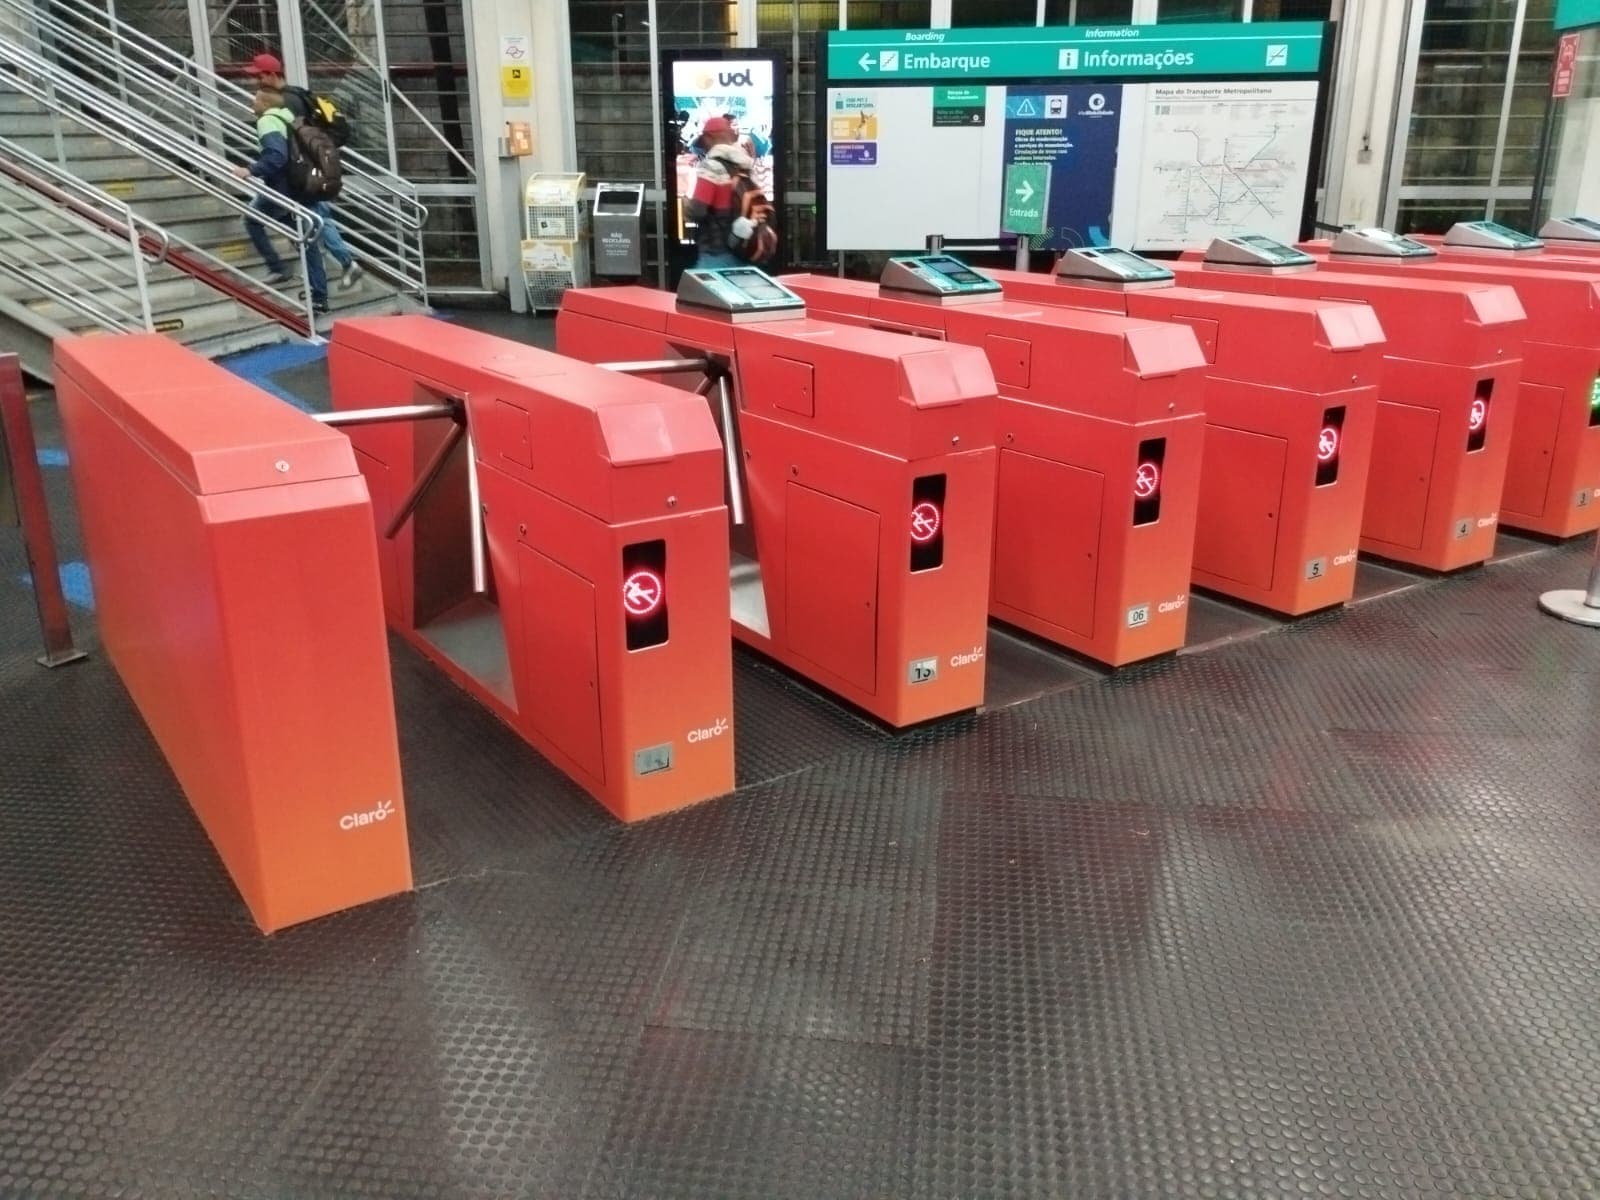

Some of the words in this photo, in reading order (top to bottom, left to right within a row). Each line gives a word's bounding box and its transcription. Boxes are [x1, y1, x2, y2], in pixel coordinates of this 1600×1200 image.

[905, 32, 945, 43] Boarding
[1085, 28, 1139, 38] Information
[904, 52, 990, 72] Embarque
[1084, 49, 1194, 71] Informações
[1035, 128, 1063, 136] ATENTO!
[1009, 208, 1039, 218] Entrada
[1333, 551, 1355, 566] Claro
[1312, 563, 1319, 576] 5
[1158, 596, 1183, 613] Claro
[1132, 609, 1144, 622] 06
[950, 648, 981, 668] Claro
[687, 720, 726, 743] Claro
[340, 803, 391, 830] Claro
